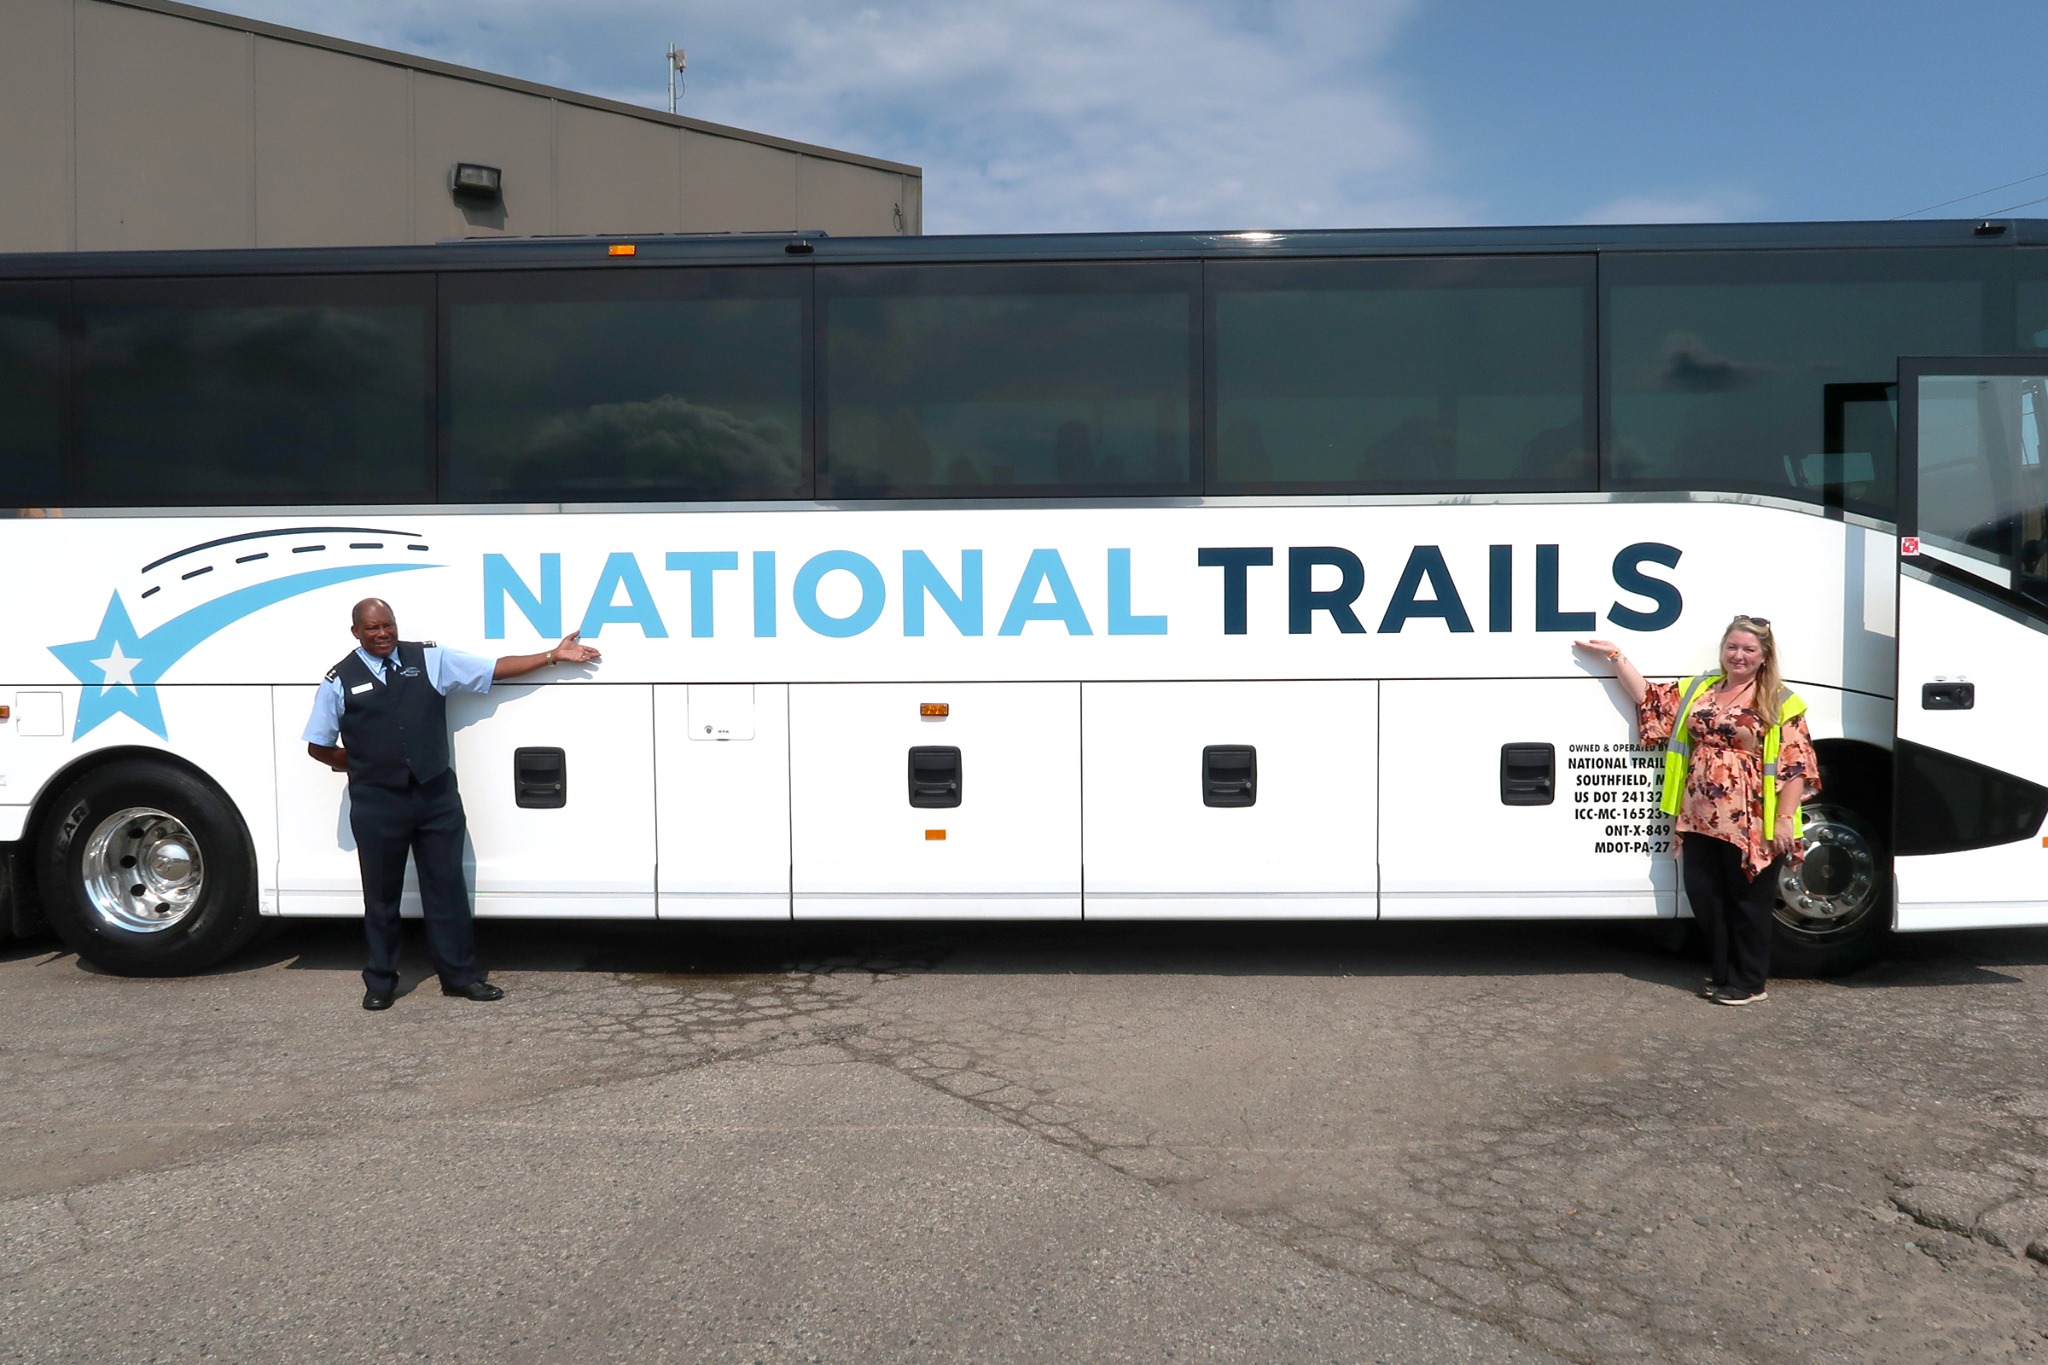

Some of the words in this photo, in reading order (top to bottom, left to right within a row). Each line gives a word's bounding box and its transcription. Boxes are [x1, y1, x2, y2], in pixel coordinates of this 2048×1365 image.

[484, 547, 1168, 640] NATIONAL
[1198, 541, 1684, 635] TRAILS
[1569, 744, 1600, 752] OWNED
[1603, 744, 1610, 752] &
[1613, 744, 1656, 752] OPERATED
[1568, 757, 1627, 769] NATIONAL
[1632, 757, 1666, 769] TRAIL
[1576, 774, 1652, 788] SOUTHFIELD,
[1574, 791, 1589, 804] US
[1593, 791, 1618, 804] DOT
[1622, 791, 1663, 804] 24132
[1605, 825, 1671, 838] ONT-X-849
[1595, 841, 1671, 854] MDOT-PA-27
